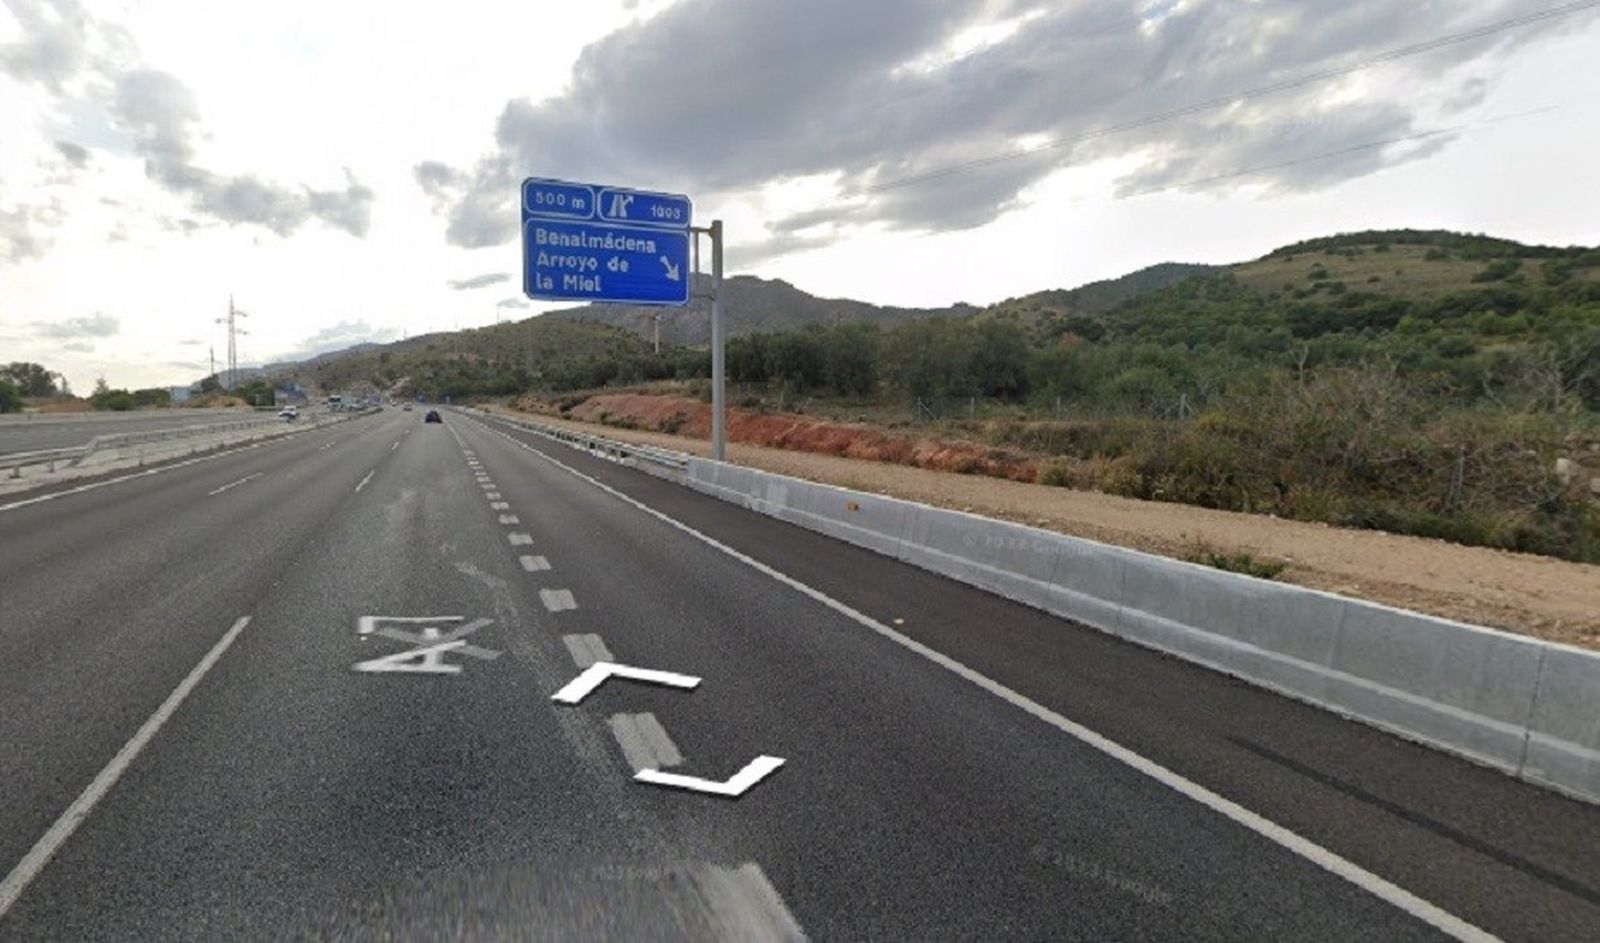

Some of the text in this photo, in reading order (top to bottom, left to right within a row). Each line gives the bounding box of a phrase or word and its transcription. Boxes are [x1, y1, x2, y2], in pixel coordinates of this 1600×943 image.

[535, 191, 585, 210] 500 m
[535, 228, 657, 254] Benalmádena
[536, 252, 630, 272] Arroyo de
[536, 273, 601, 292] la Miel
